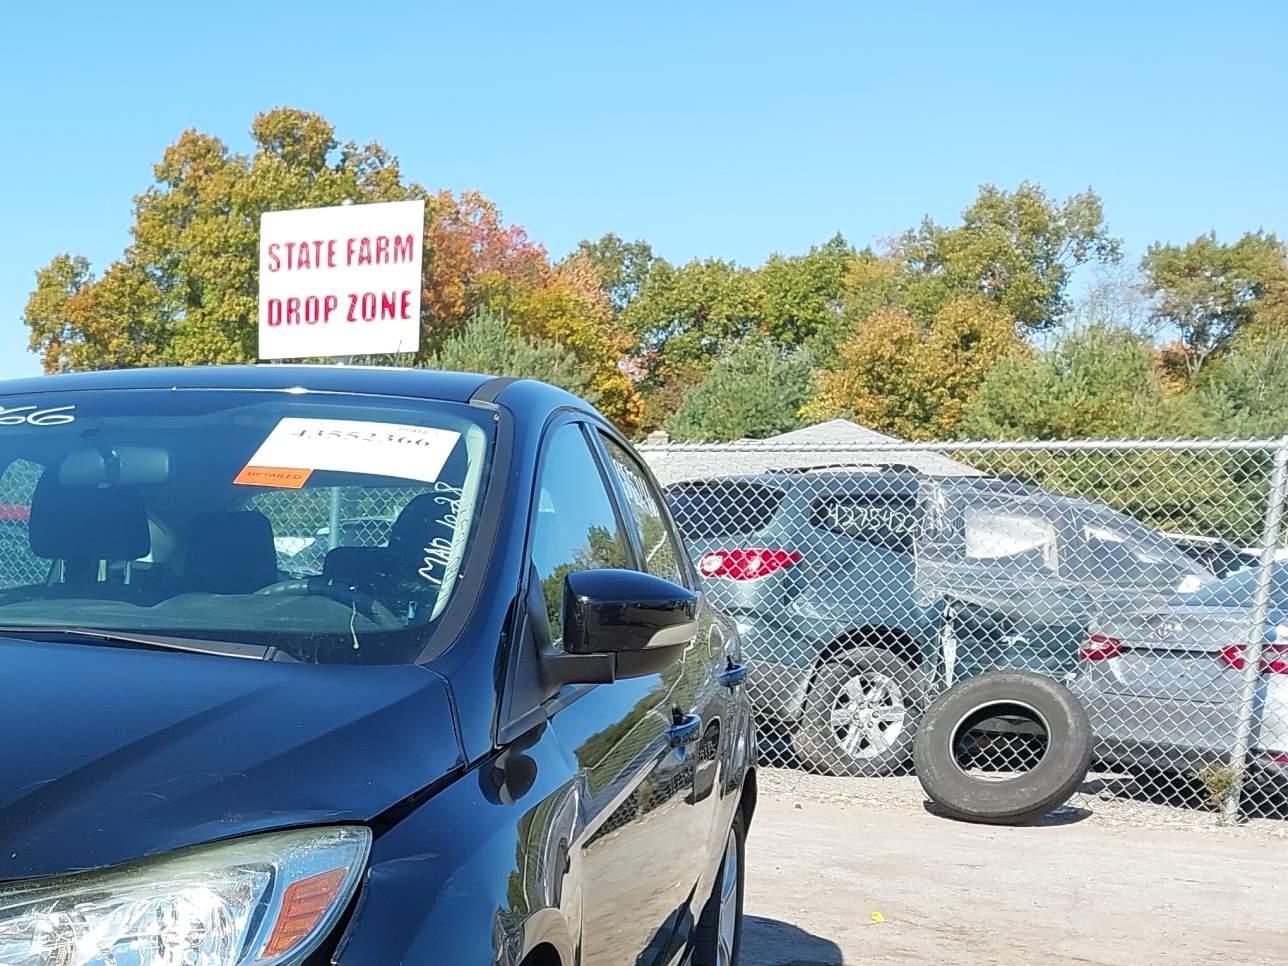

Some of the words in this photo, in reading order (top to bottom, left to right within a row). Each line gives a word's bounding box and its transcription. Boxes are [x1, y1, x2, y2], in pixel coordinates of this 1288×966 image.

[268, 239, 337, 274] STATE
[346, 234, 414, 267] FARM
[268, 295, 338, 327] DROP
[346, 290, 411, 322] ZONE
[246, 471, 303, 481] DETAILED
